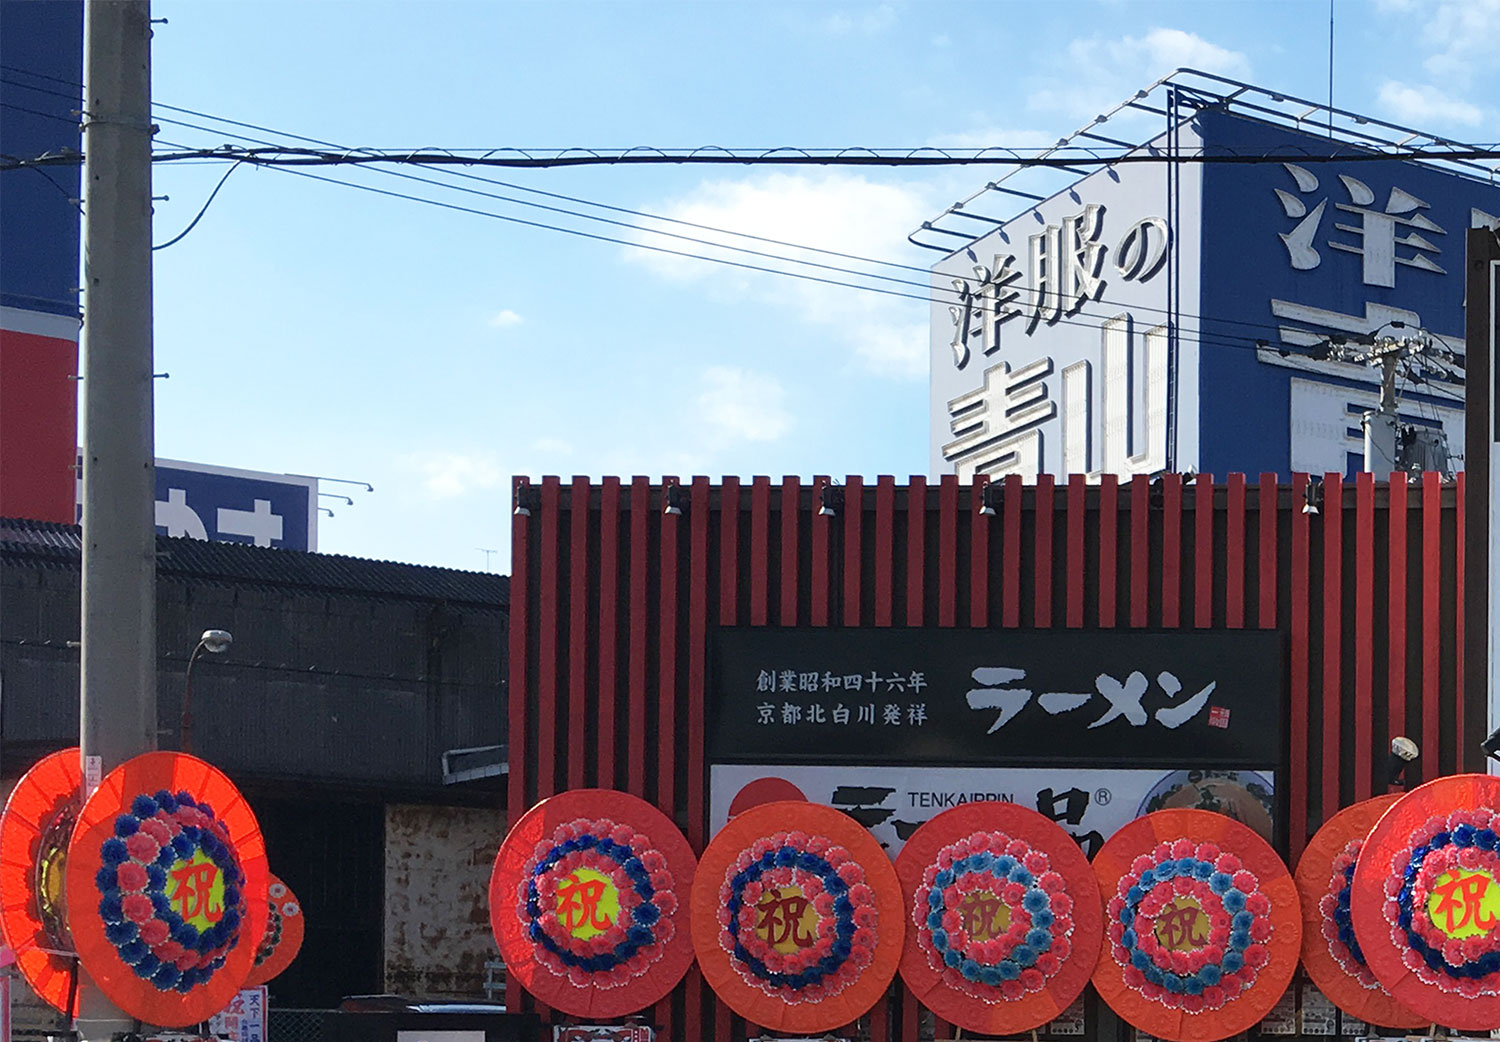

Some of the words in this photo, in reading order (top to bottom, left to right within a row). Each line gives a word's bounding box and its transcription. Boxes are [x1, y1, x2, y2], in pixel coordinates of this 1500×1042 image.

[949, 203, 1169, 369] 洋服の
[756, 669, 928, 693] 創業昭和四十六年
[966, 666, 1216, 735] ラーメン
[756, 701, 928, 726] 京都北白川発祥
[171, 859, 224, 923] 祝
[556, 874, 613, 932] 祝
[757, 890, 814, 947] 祝
[958, 894, 1009, 938] 祝
[1433, 869, 1496, 934] 祝
[1160, 903, 1208, 949] 祝
